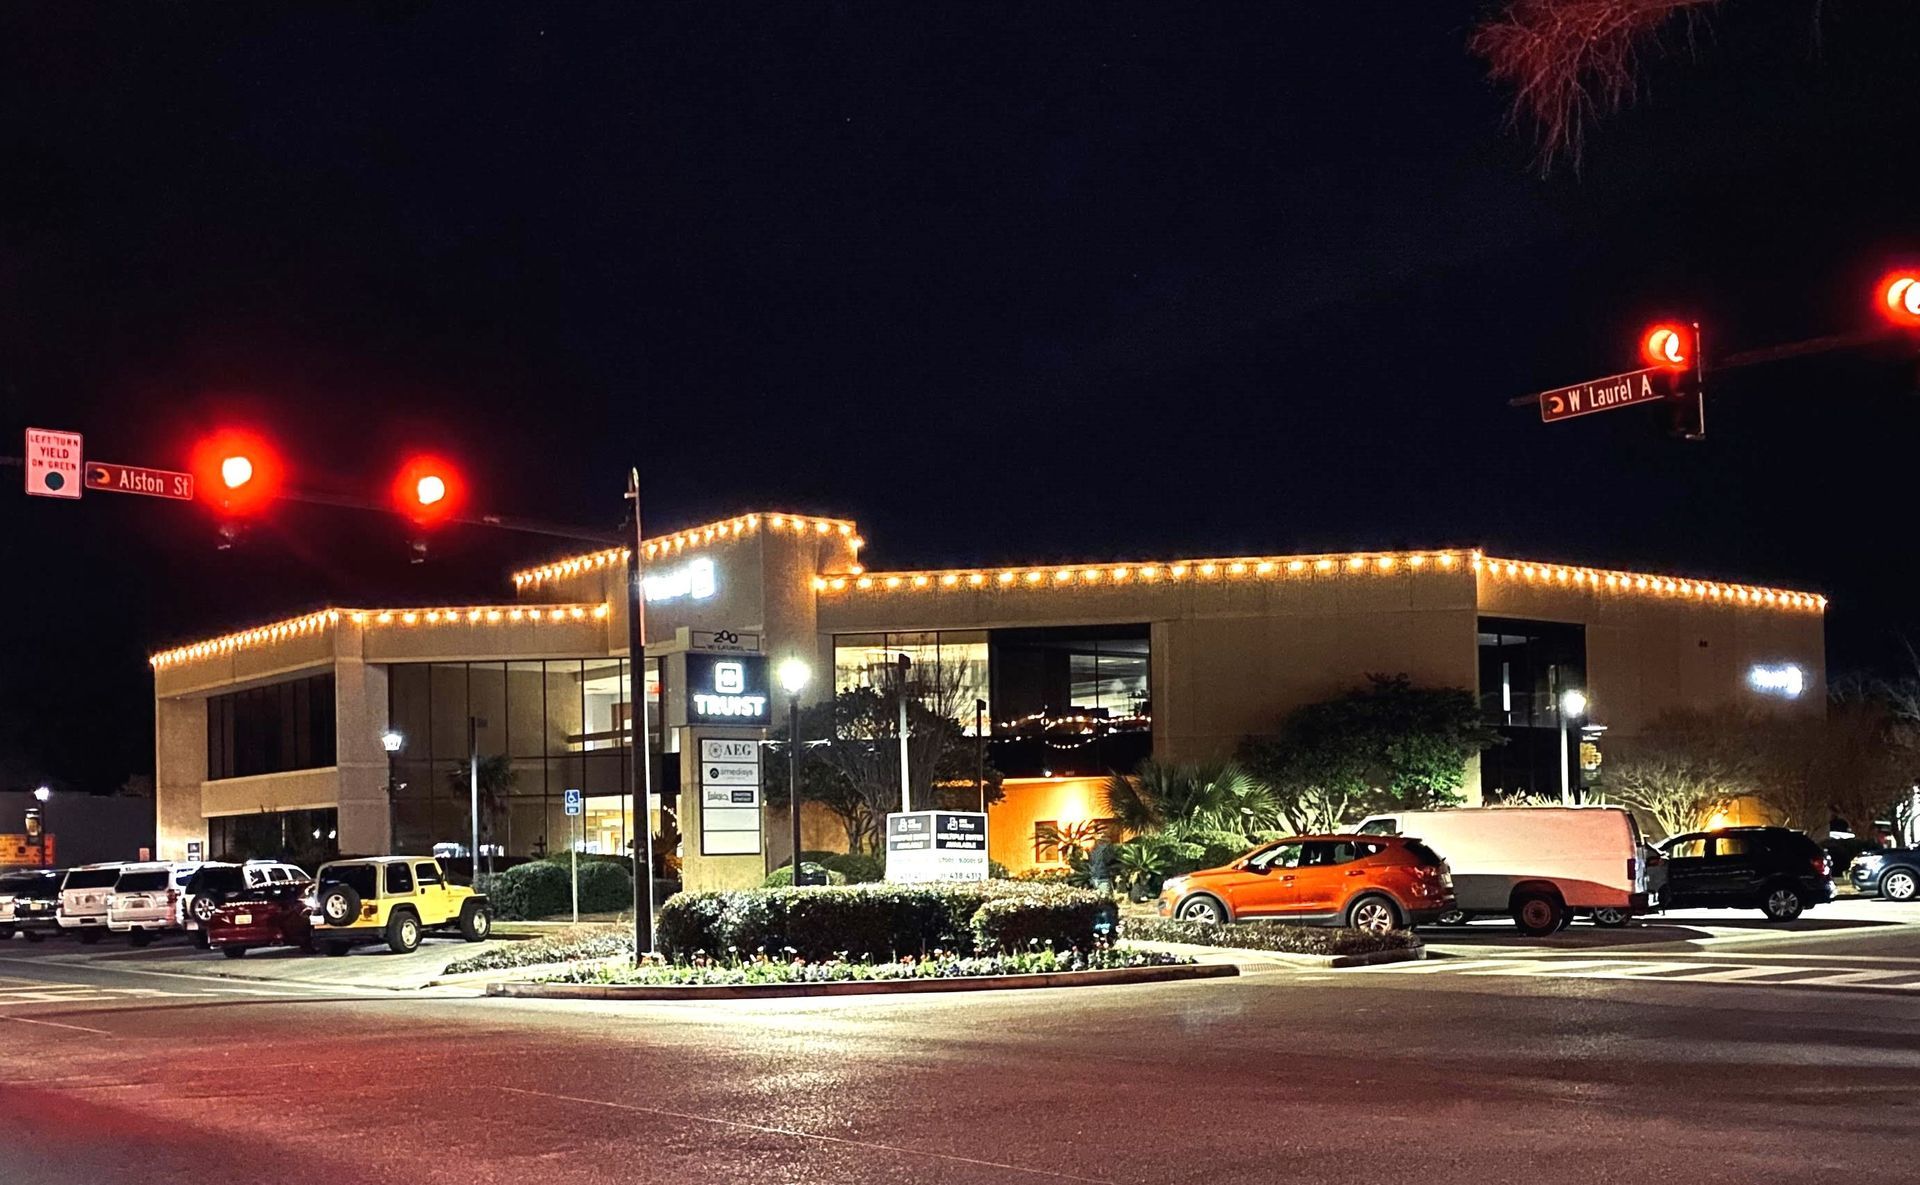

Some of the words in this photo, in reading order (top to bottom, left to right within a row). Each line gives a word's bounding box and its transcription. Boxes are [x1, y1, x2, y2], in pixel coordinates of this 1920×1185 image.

[1568, 390, 1580, 412] W
[1590, 379, 1632, 408] Laurel
[1641, 374, 1652, 397] A
[31, 434, 51, 444] LEFT
[53, 436, 78, 447] TURN
[40, 446, 69, 459] YIELD
[32, 458, 43, 467] ON
[48, 460, 76, 470] GREEN
[119, 470, 164, 493] Alston
[174, 477, 189, 495] St
[713, 629, 738, 644] 200
[693, 694, 766, 717] TRUIST
[723, 743, 752, 756] AEG
